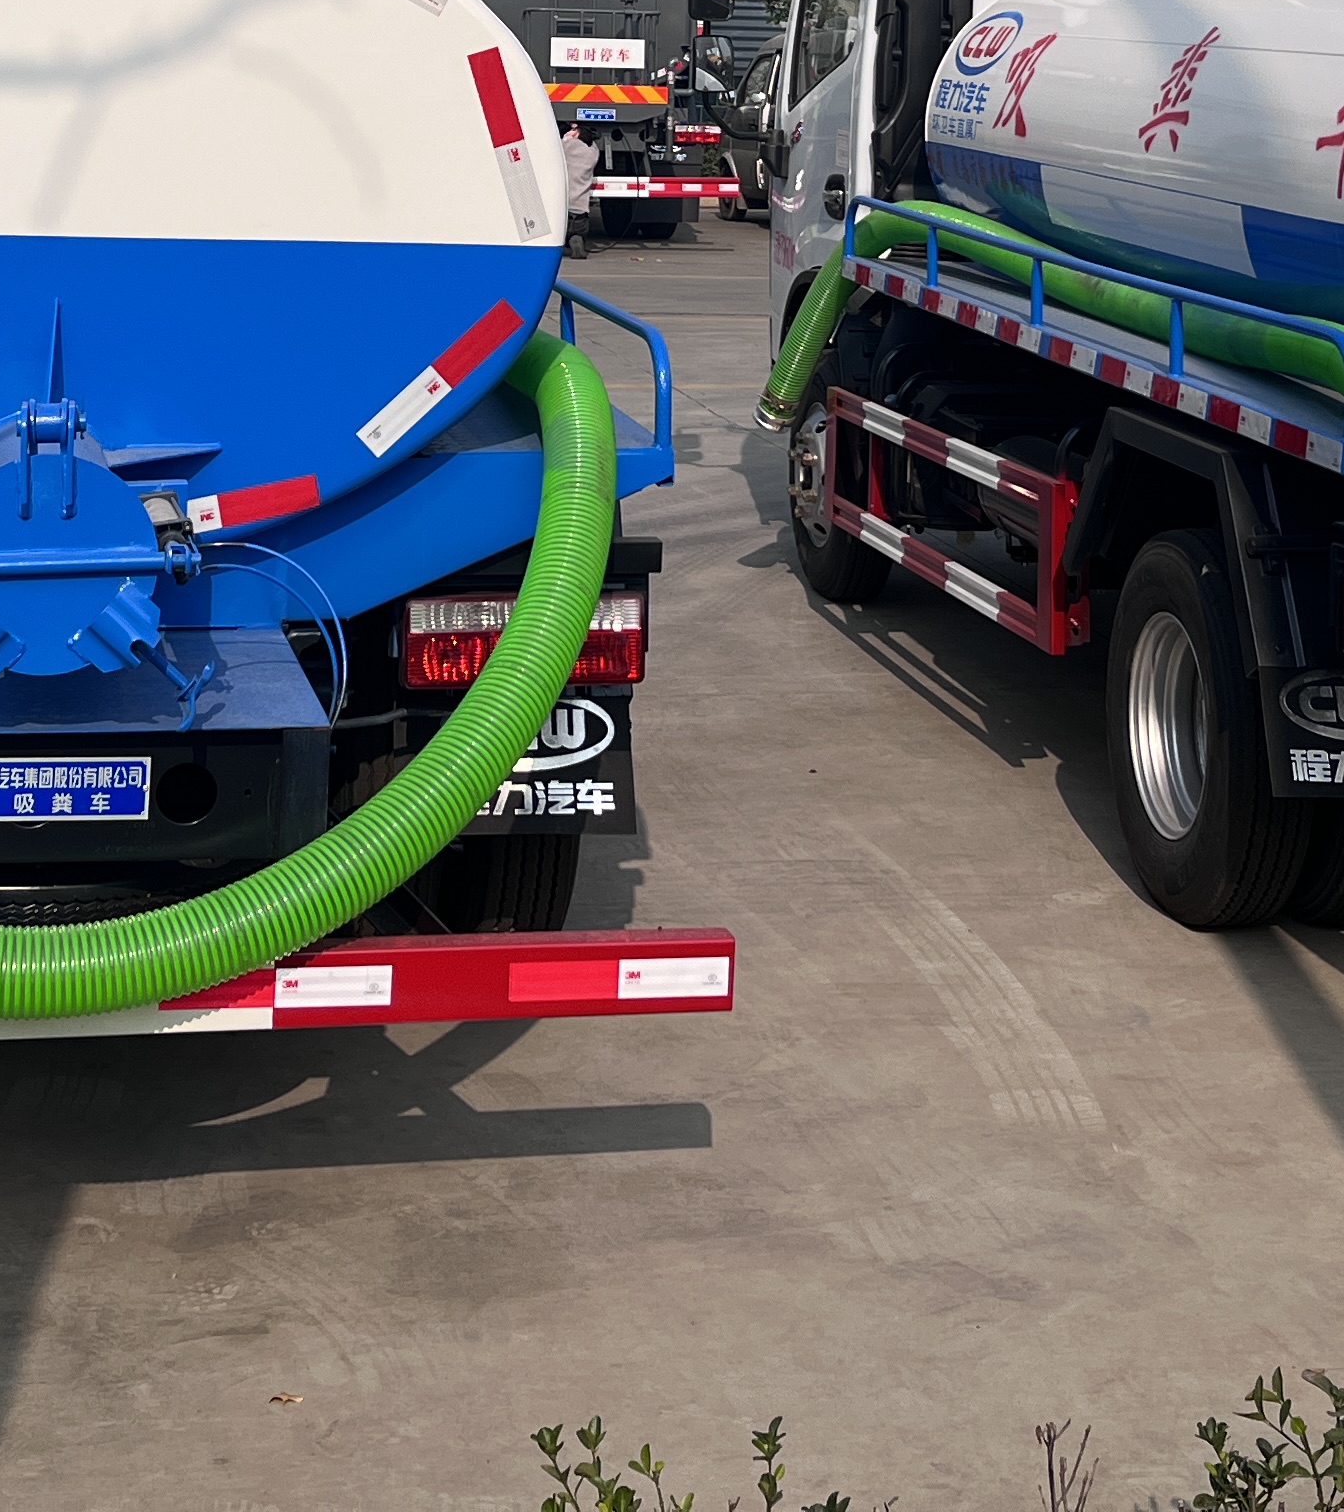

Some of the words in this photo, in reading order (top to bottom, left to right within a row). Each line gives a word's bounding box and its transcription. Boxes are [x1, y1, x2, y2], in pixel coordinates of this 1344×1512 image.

[962, 25, 1016, 59] CLW
[935, 78, 991, 115] 程力汽车
[511, 147, 521, 162] 3M
[13, 792, 111, 814] 吸粪车
[476, 779, 616, 816] 力汽车
[282, 979, 299, 989] 3M
[625, 971, 641, 980] 3M
